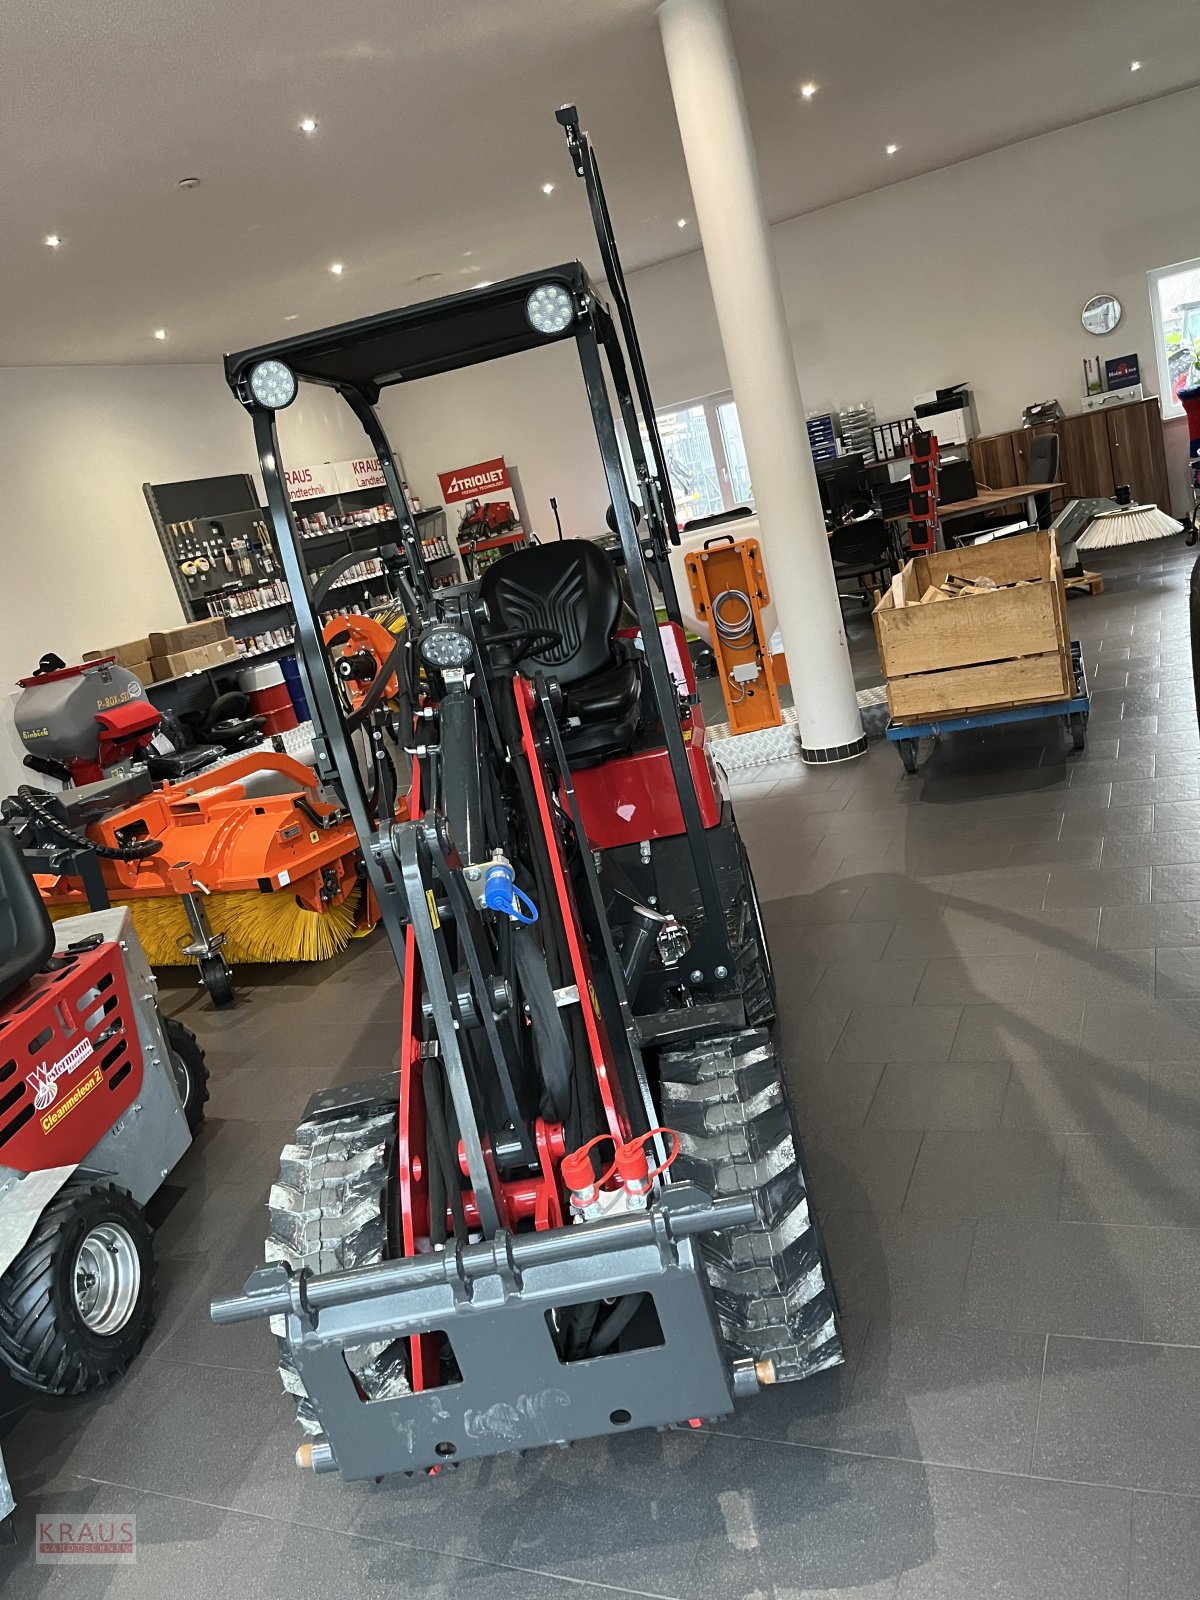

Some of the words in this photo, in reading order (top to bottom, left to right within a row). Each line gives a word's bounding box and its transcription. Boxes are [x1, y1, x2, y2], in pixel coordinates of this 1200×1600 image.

[352, 459, 382, 474] KRAUS
[284, 469, 312, 484] RAUS
[356, 475, 385, 487] Landtec
[288, 485, 325, 499] ndtechnik
[26, 1039, 91, 1096] Westermann
[42, 1078, 96, 1131] Cleanmeleon
[94, 1070, 102, 1082] 2
